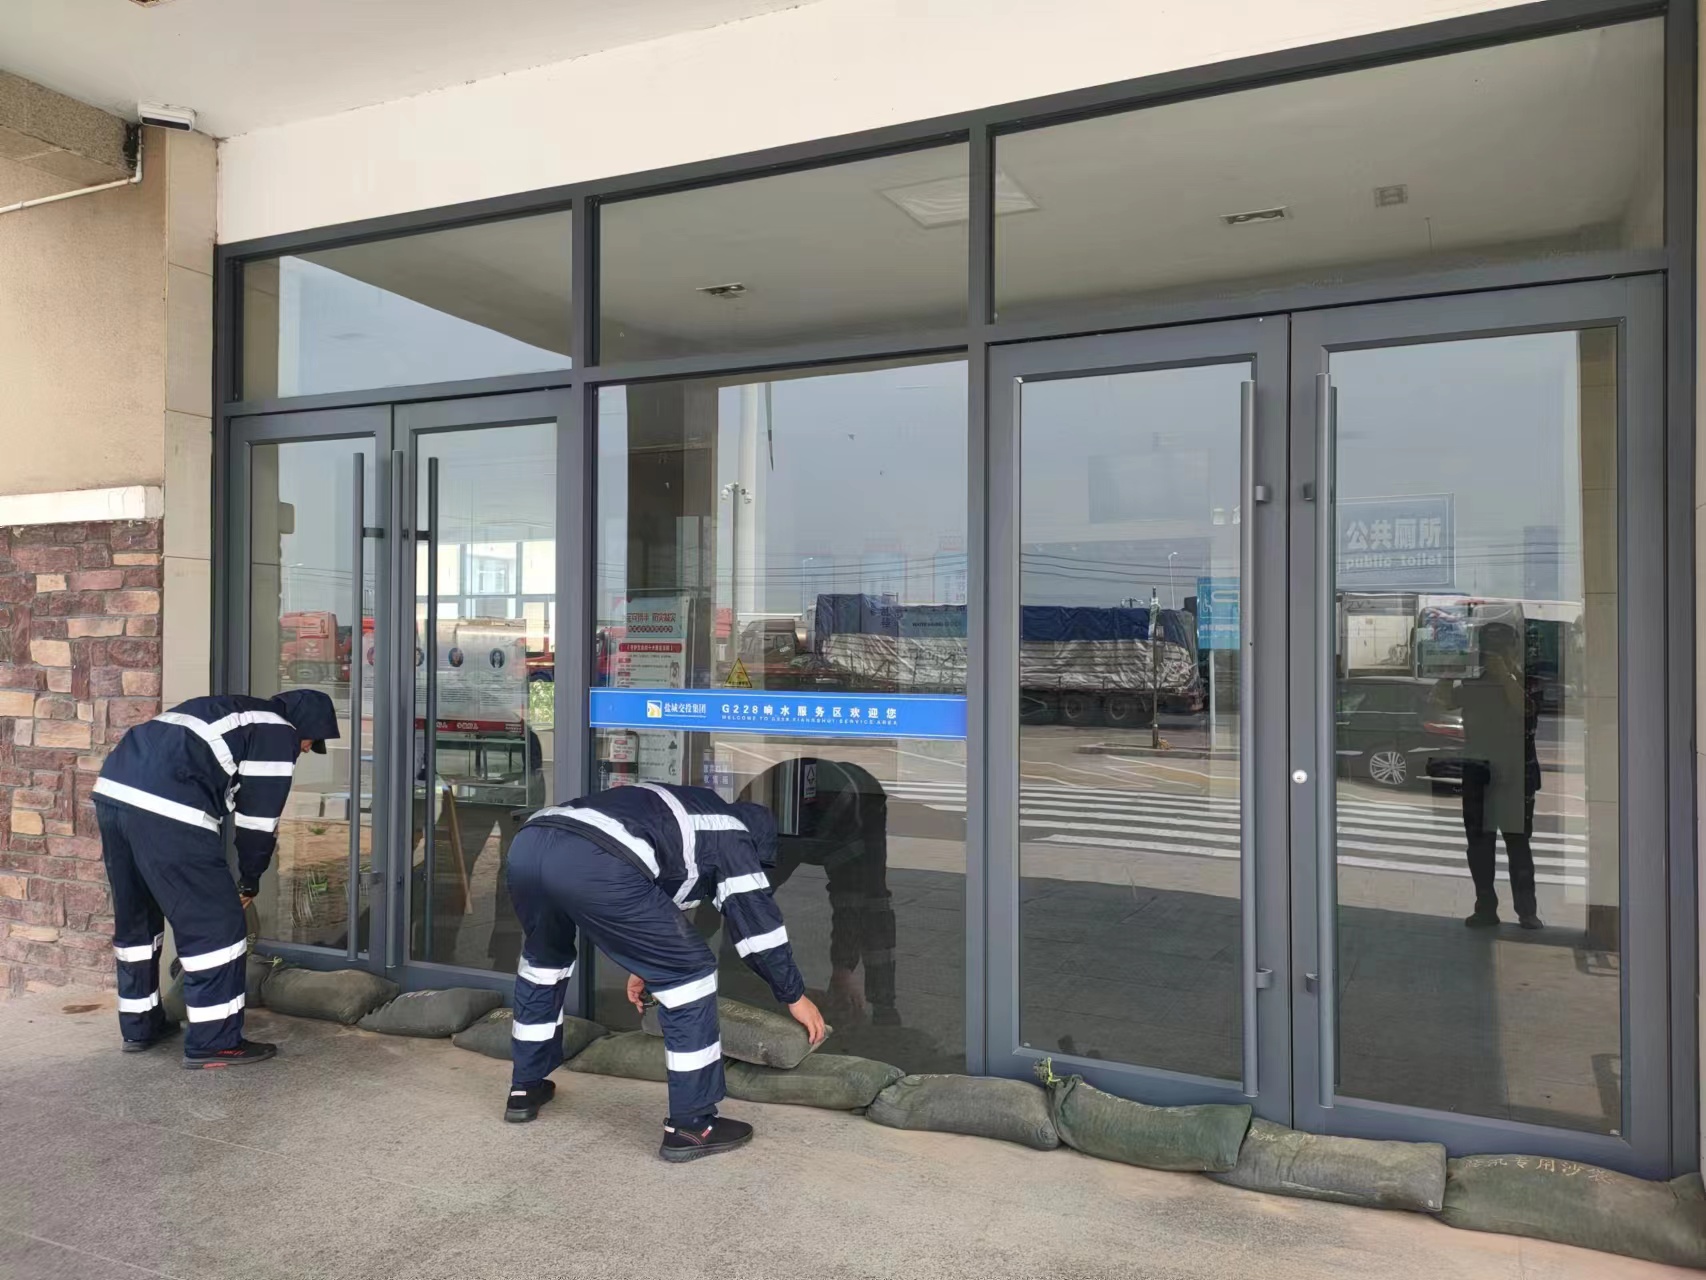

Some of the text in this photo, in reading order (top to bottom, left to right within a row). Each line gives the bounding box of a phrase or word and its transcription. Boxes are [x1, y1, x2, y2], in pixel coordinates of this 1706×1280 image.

[1346, 518, 1441, 550] 公共厕所
[1346, 552, 1442, 570] public toilet
[663, 702, 707, 714] 盐城交投集团
